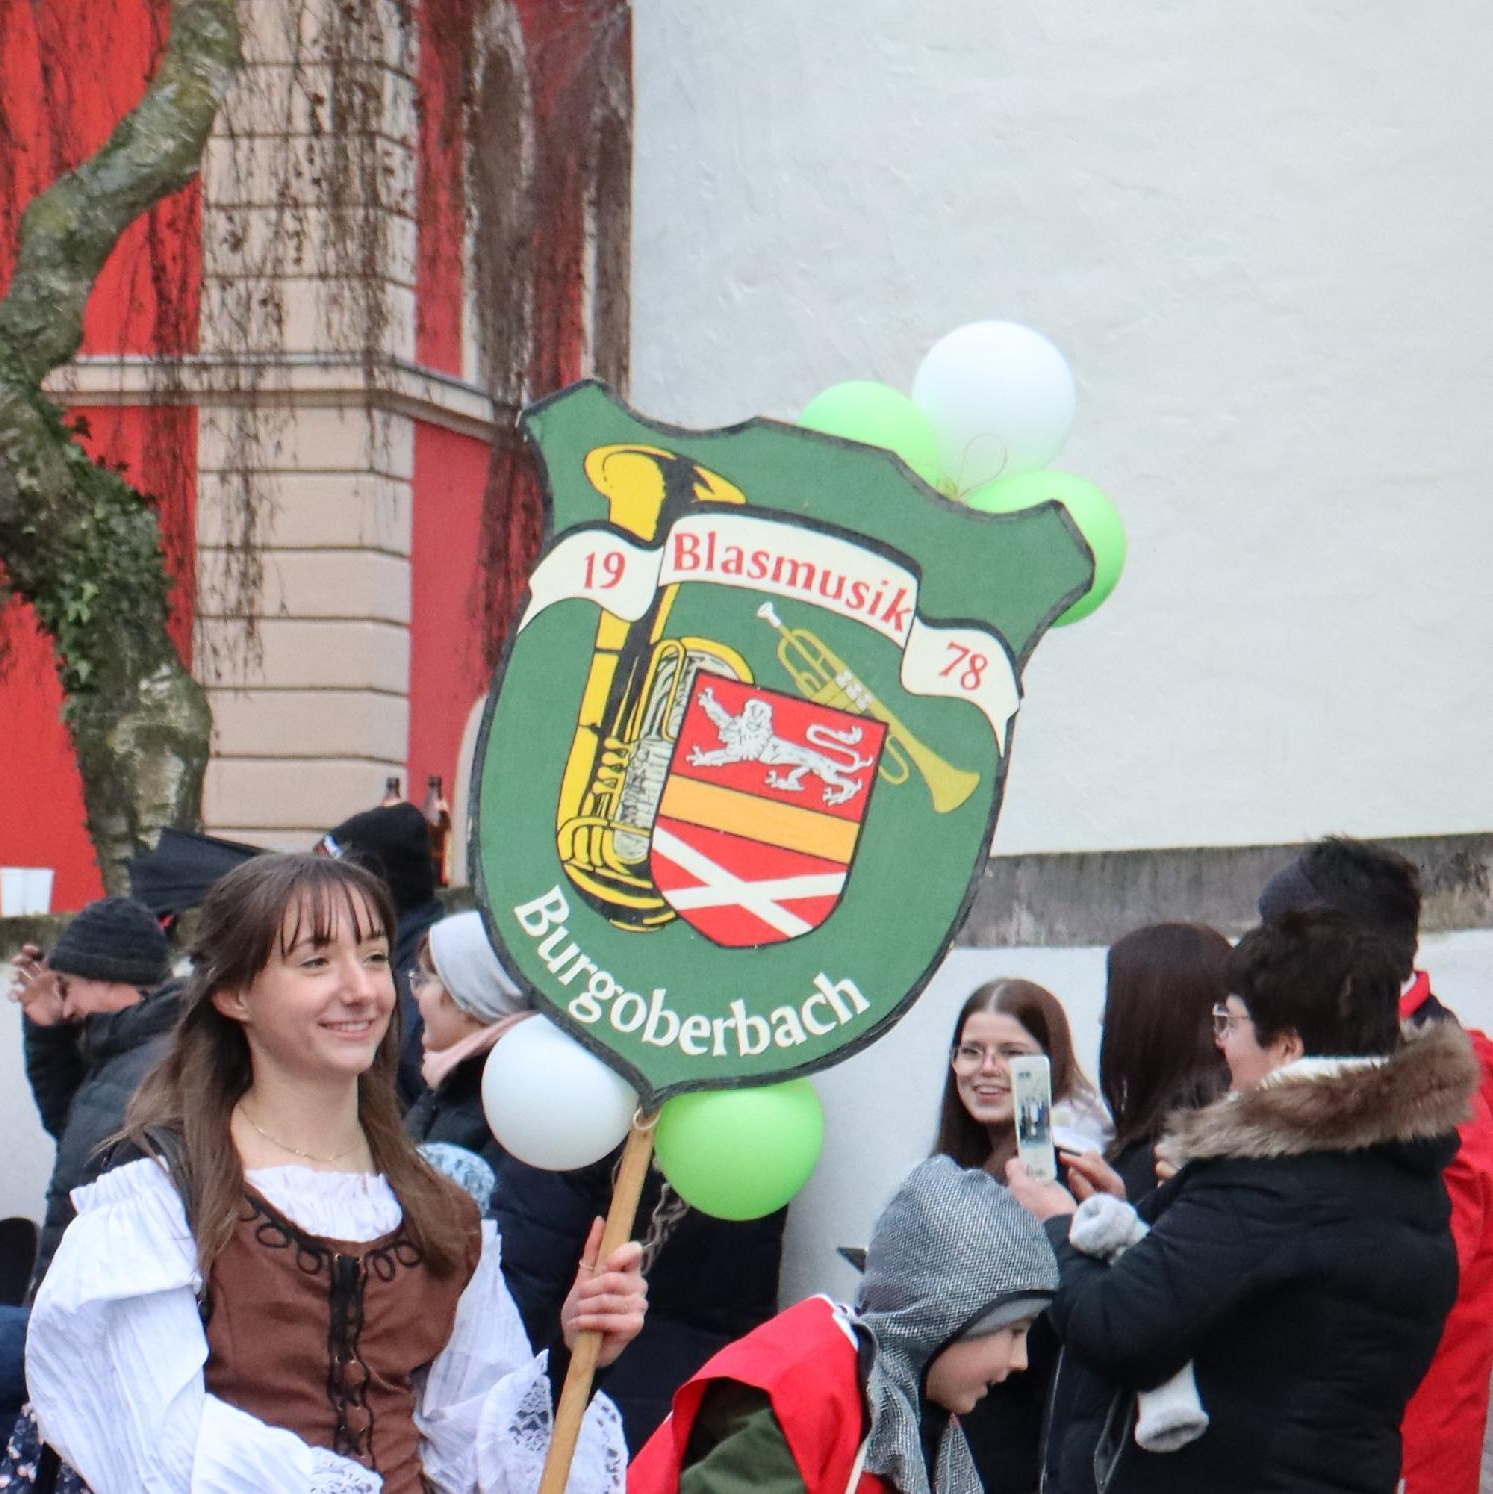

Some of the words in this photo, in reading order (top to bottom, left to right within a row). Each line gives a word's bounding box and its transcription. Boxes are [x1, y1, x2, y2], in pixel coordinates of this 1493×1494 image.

[583, 552, 626, 591] 19
[671, 531, 913, 634] Blasmusik
[938, 641, 988, 692] 78
[514, 884, 870, 1057] Burgoberbach
